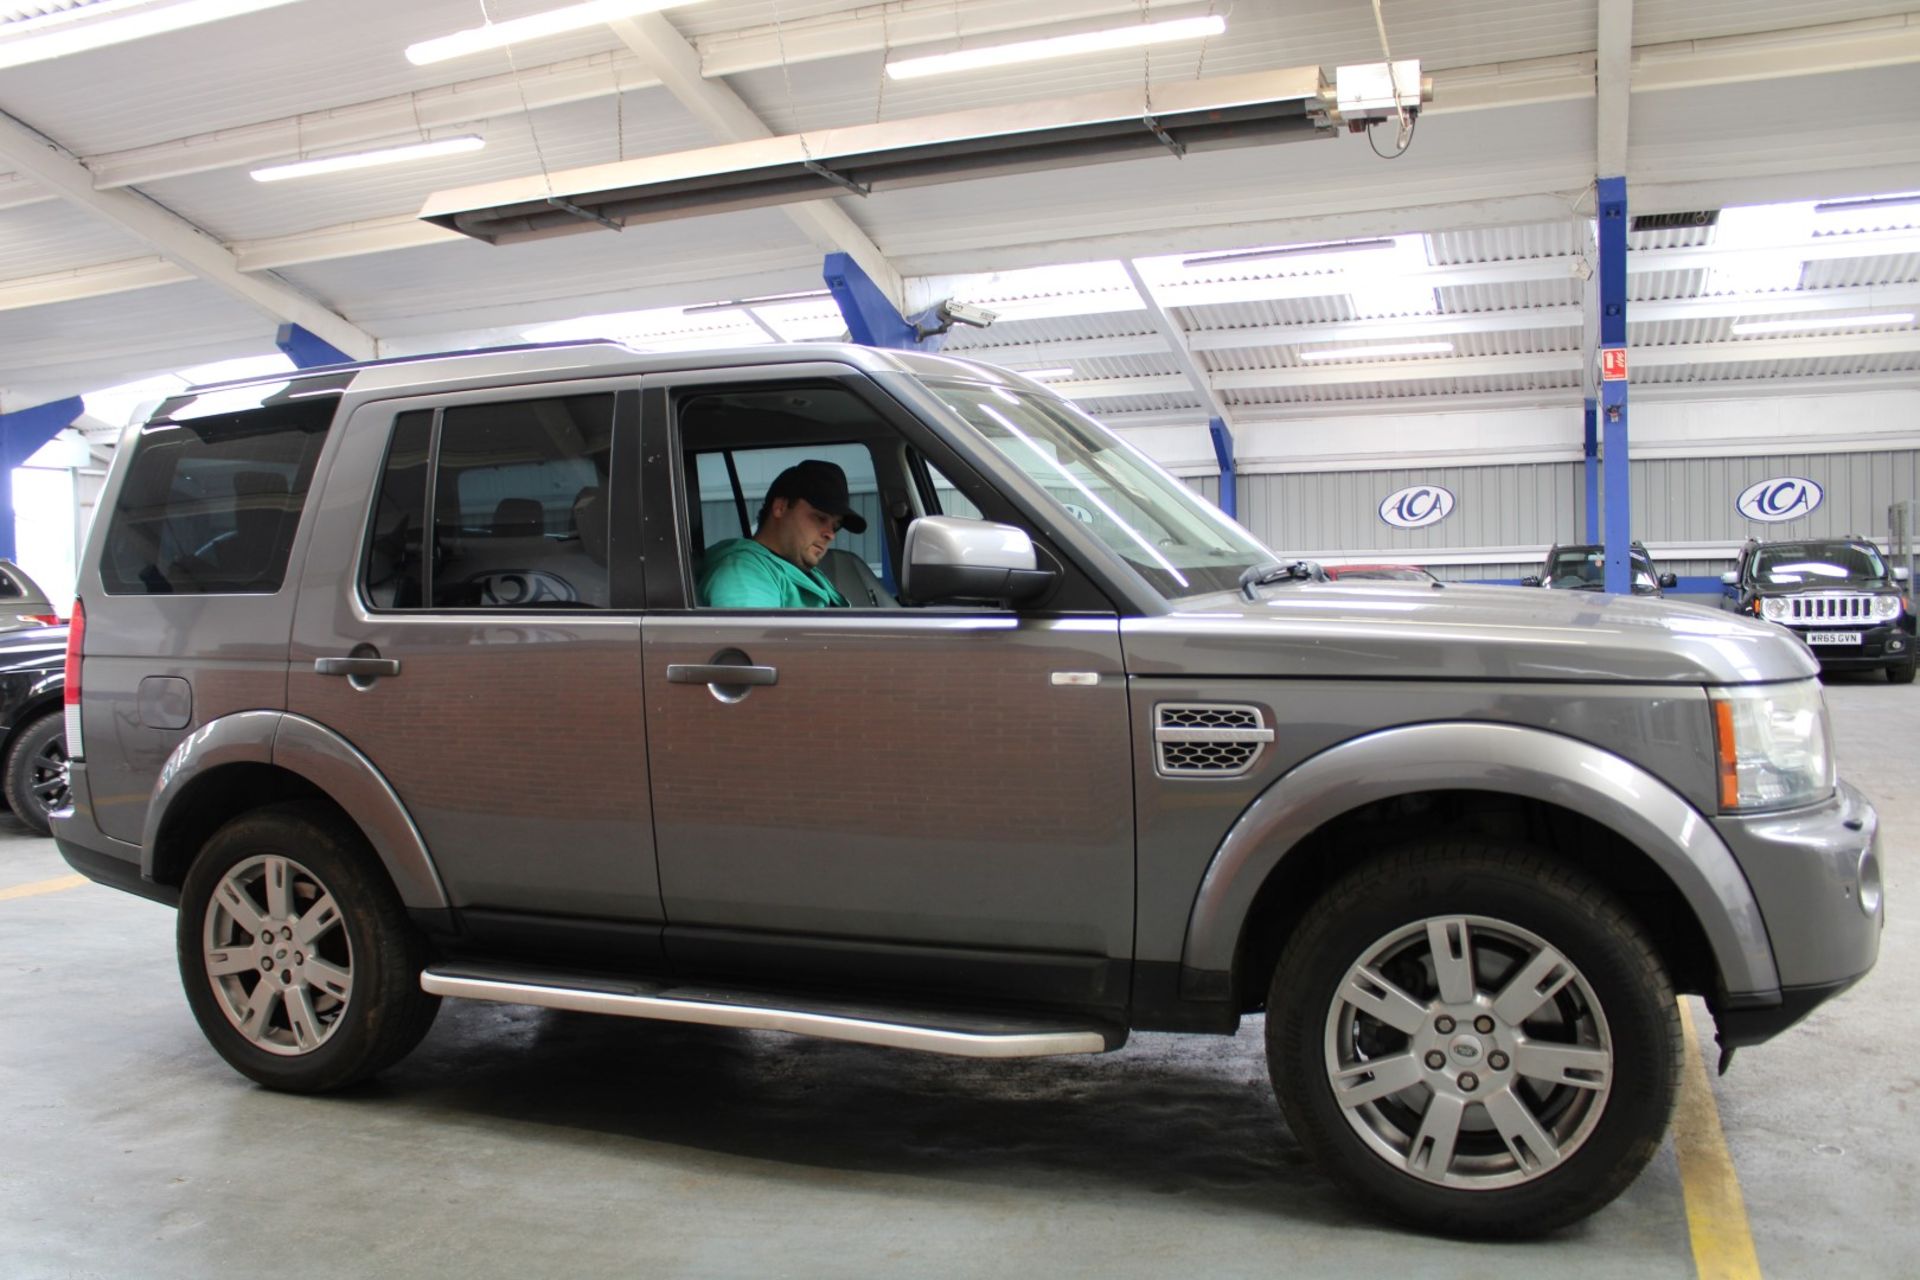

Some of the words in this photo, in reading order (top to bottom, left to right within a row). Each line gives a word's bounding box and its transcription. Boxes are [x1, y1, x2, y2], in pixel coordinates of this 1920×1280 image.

[1384, 489, 1443, 521] ACA
[1743, 481, 1809, 515] ACA
[1811, 633, 1836, 643] WR65
[1837, 633, 1857, 643] GVN
